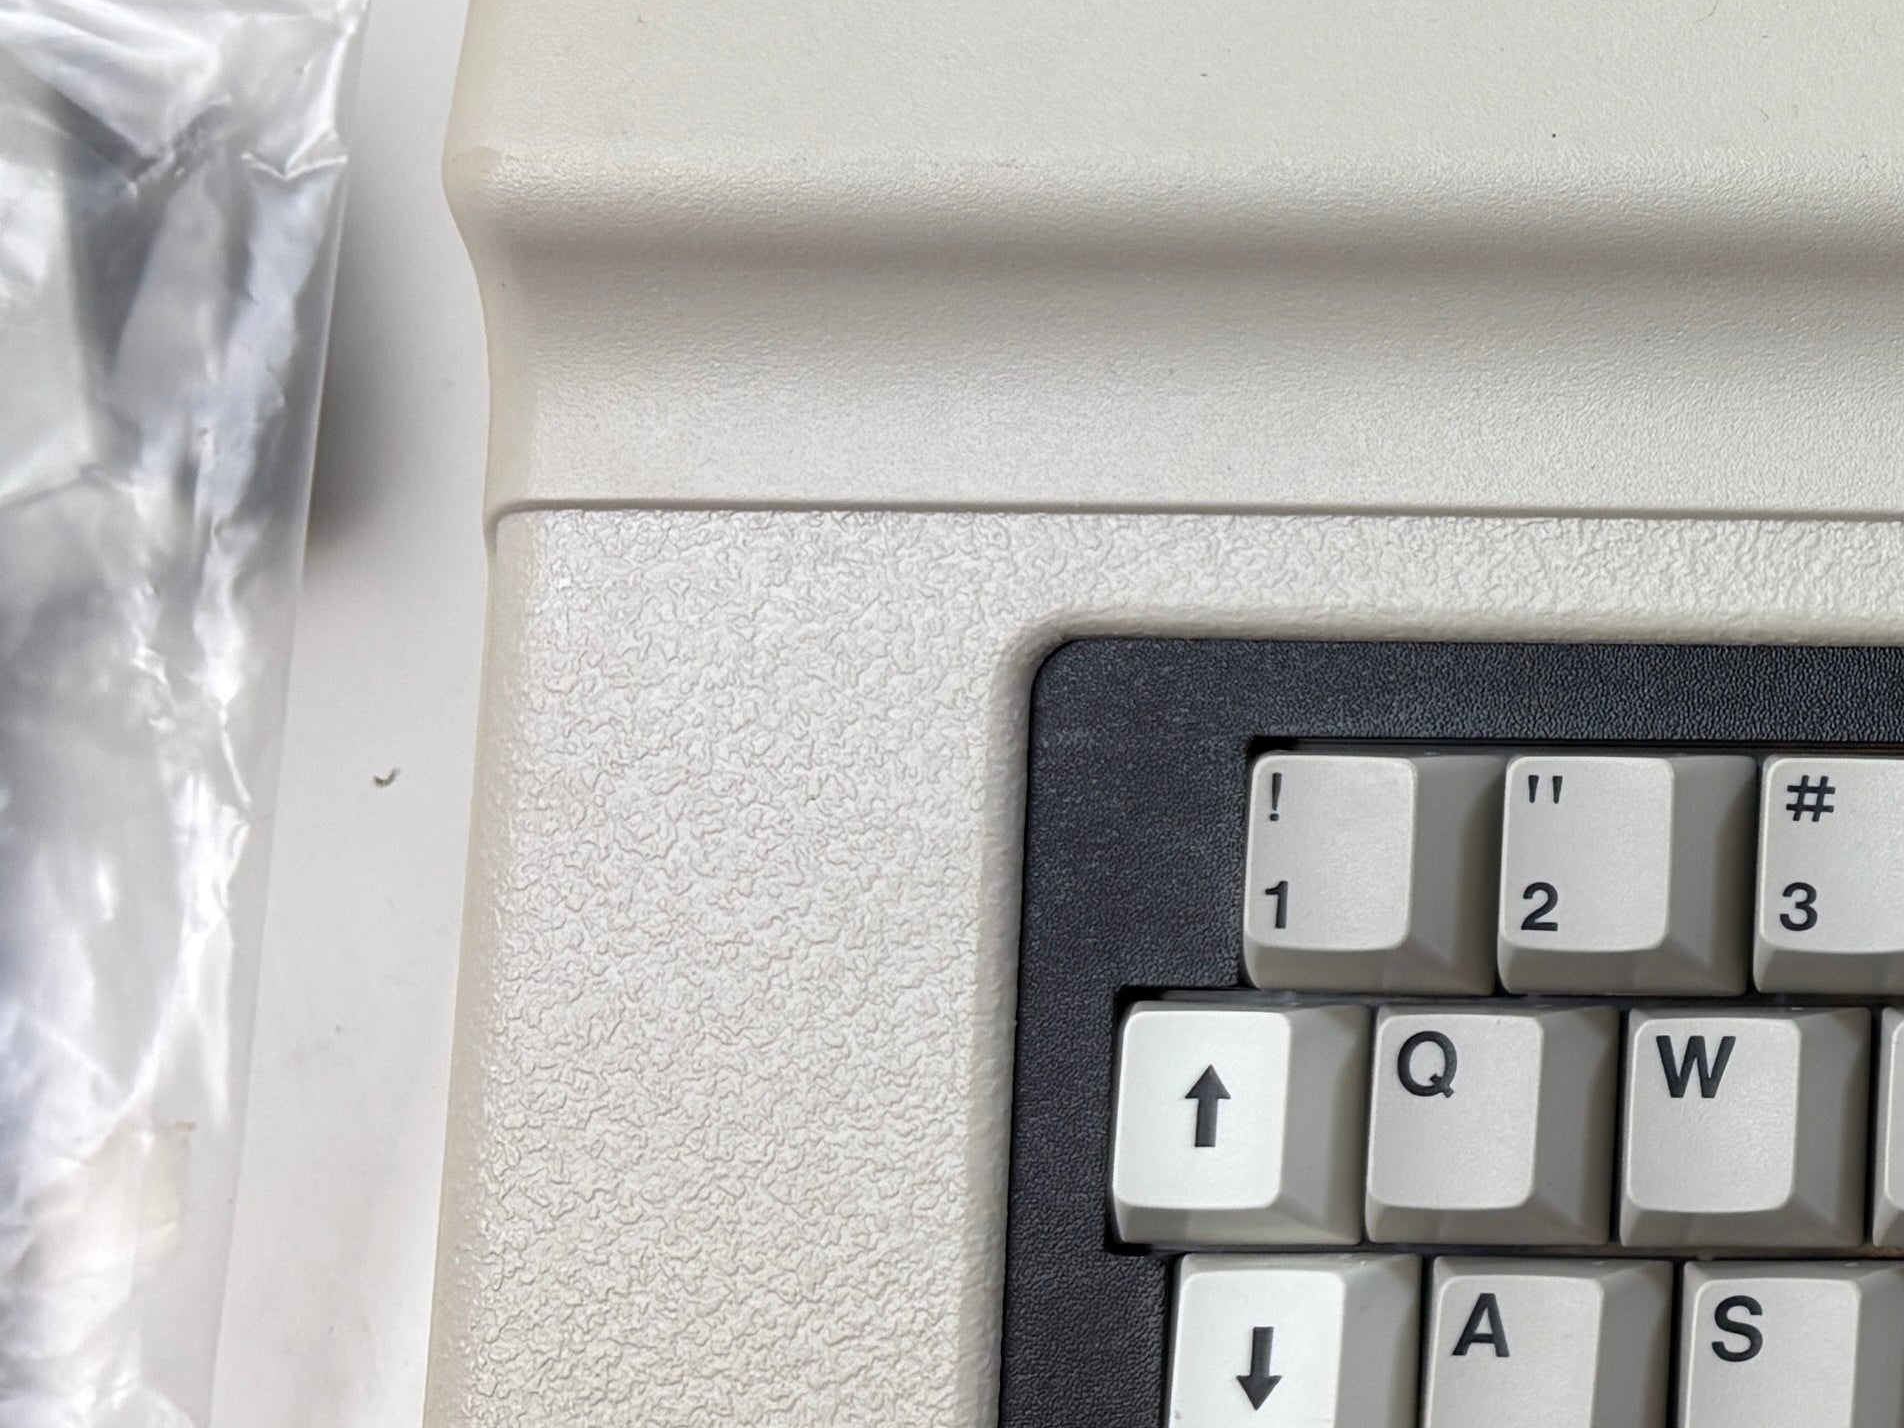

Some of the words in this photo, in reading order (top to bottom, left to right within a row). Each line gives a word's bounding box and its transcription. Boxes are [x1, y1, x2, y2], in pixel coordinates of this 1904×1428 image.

[1270, 773, 1281, 821] !
[1528, 775, 1562, 803] "
[1786, 775, 1835, 822] #
[1265, 881, 1288, 928] 1
[1521, 882, 1557, 931] 2
[1780, 882, 1817, 931] 3
[1397, 1031, 1457, 1098] Q
[1656, 1036, 1735, 1098] W
[1452, 1293, 1509, 1357] A
[1712, 1296, 1762, 1362] S
